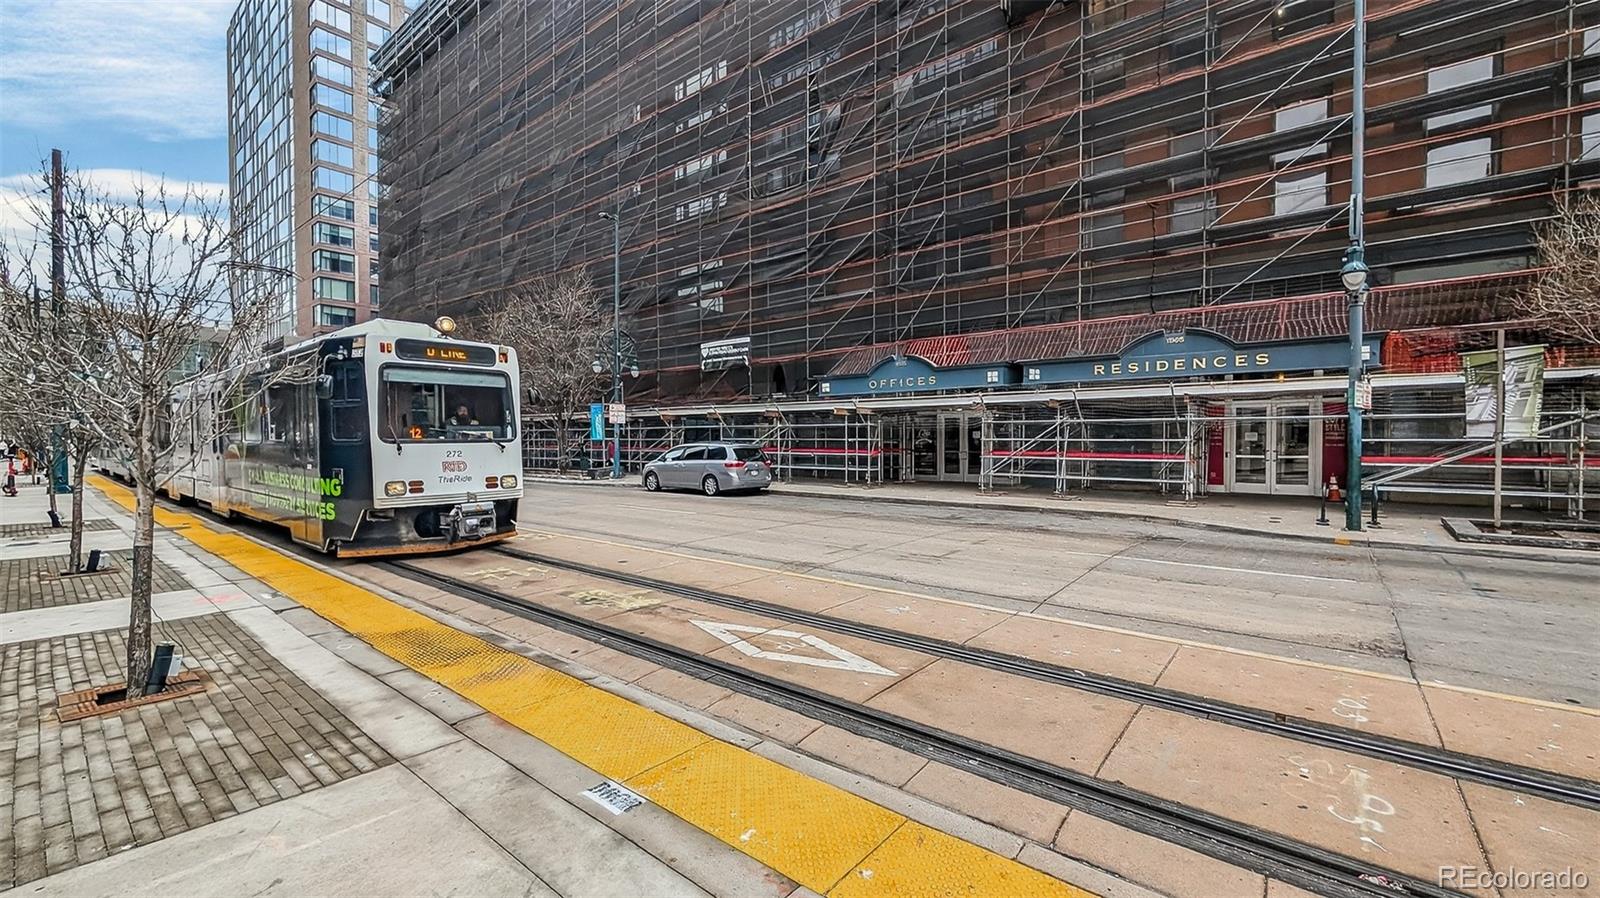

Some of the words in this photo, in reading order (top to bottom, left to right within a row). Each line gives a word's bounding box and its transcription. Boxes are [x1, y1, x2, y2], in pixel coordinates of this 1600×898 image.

[440, 350, 467, 360] LINE
[1094, 353, 1270, 376] RESIDENCES
[868, 375, 937, 389] OFFICES
[409, 427, 422, 439] 12
[446, 450, 463, 458] 272
[438, 474, 473, 484] TheRide
